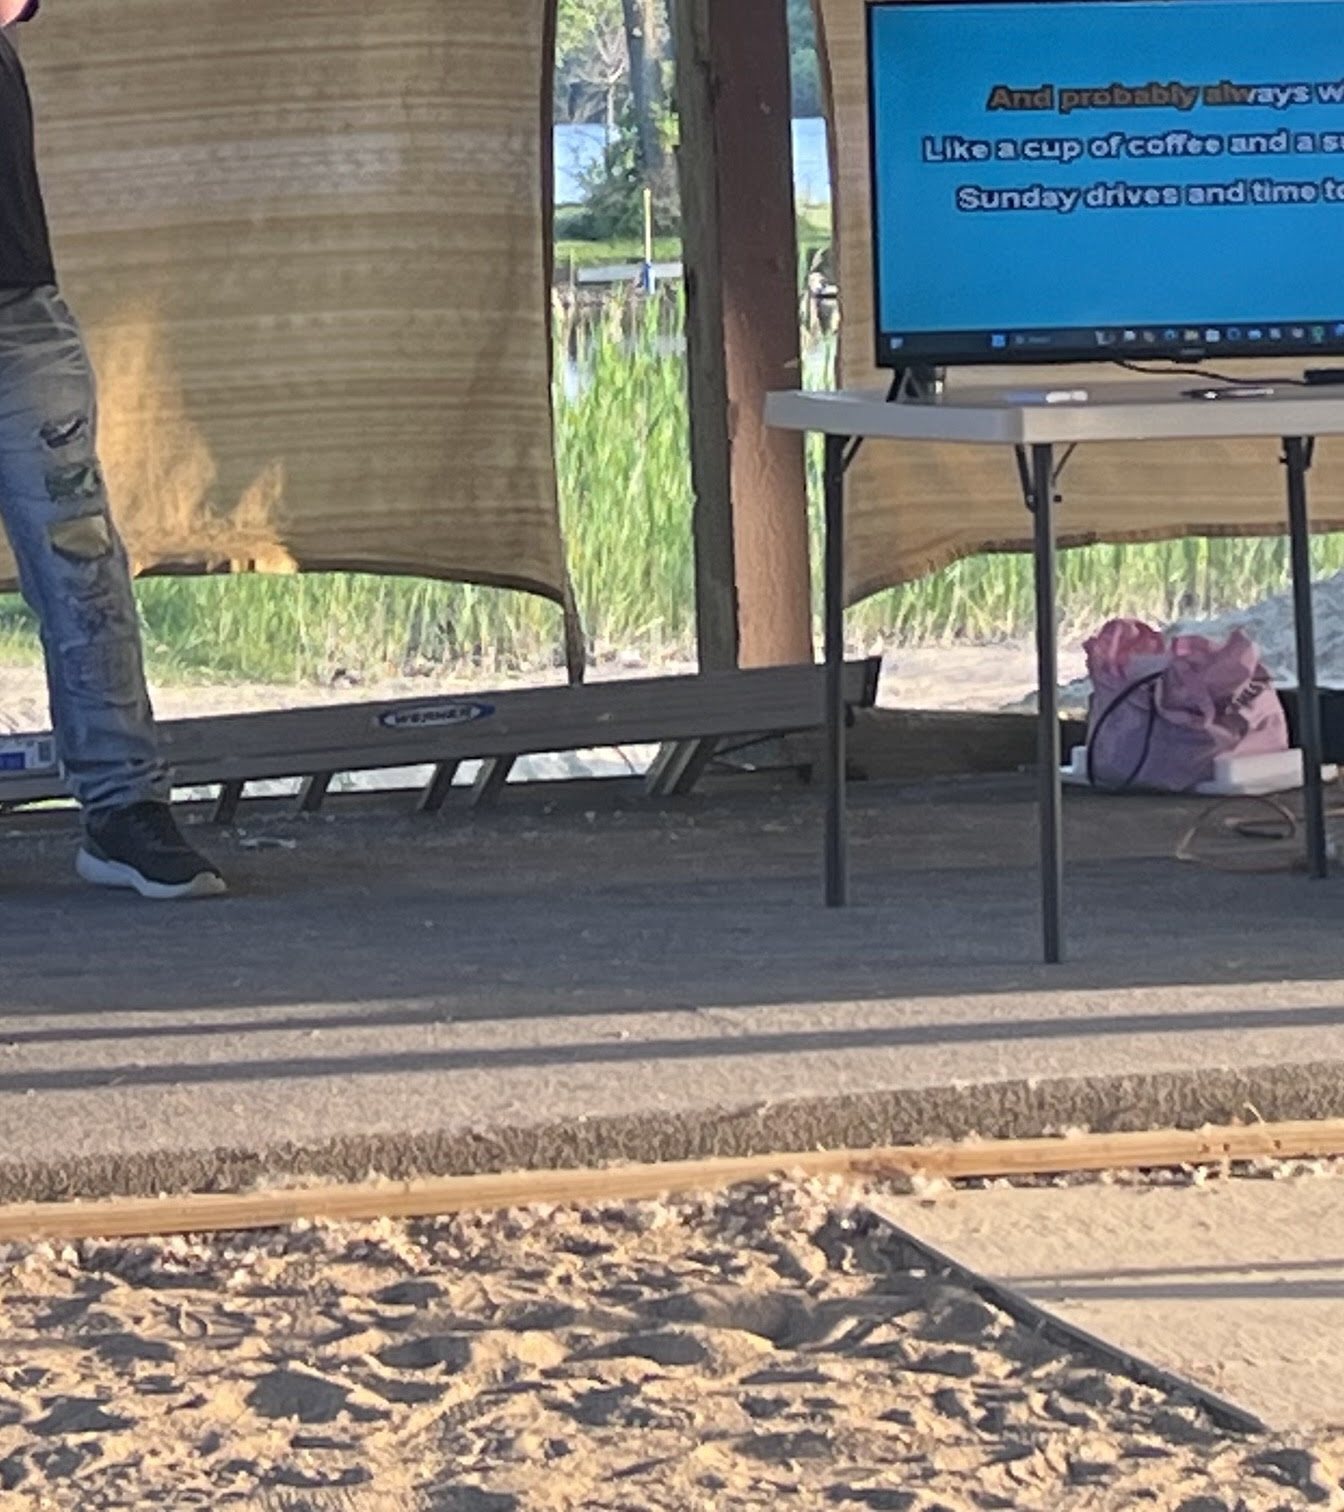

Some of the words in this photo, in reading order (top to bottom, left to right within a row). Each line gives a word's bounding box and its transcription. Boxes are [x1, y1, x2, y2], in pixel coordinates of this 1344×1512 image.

[988, 85, 1053, 110] And
[1060, 82, 1199, 113] probably
[1204, 80, 1310, 108] always
[923, 138, 989, 161] Like
[997, 140, 1017, 159] a
[1023, 138, 1083, 162] cup
[1090, 134, 1124, 157] of
[1127, 131, 1221, 155] coffee
[1229, 130, 1288, 154] and
[1296, 134, 1314, 153] a
[958, 186, 1080, 212] Sunday
[1086, 184, 1179, 207] drives
[1187, 181, 1246, 204] and
[1250, 179, 1317, 202] time
